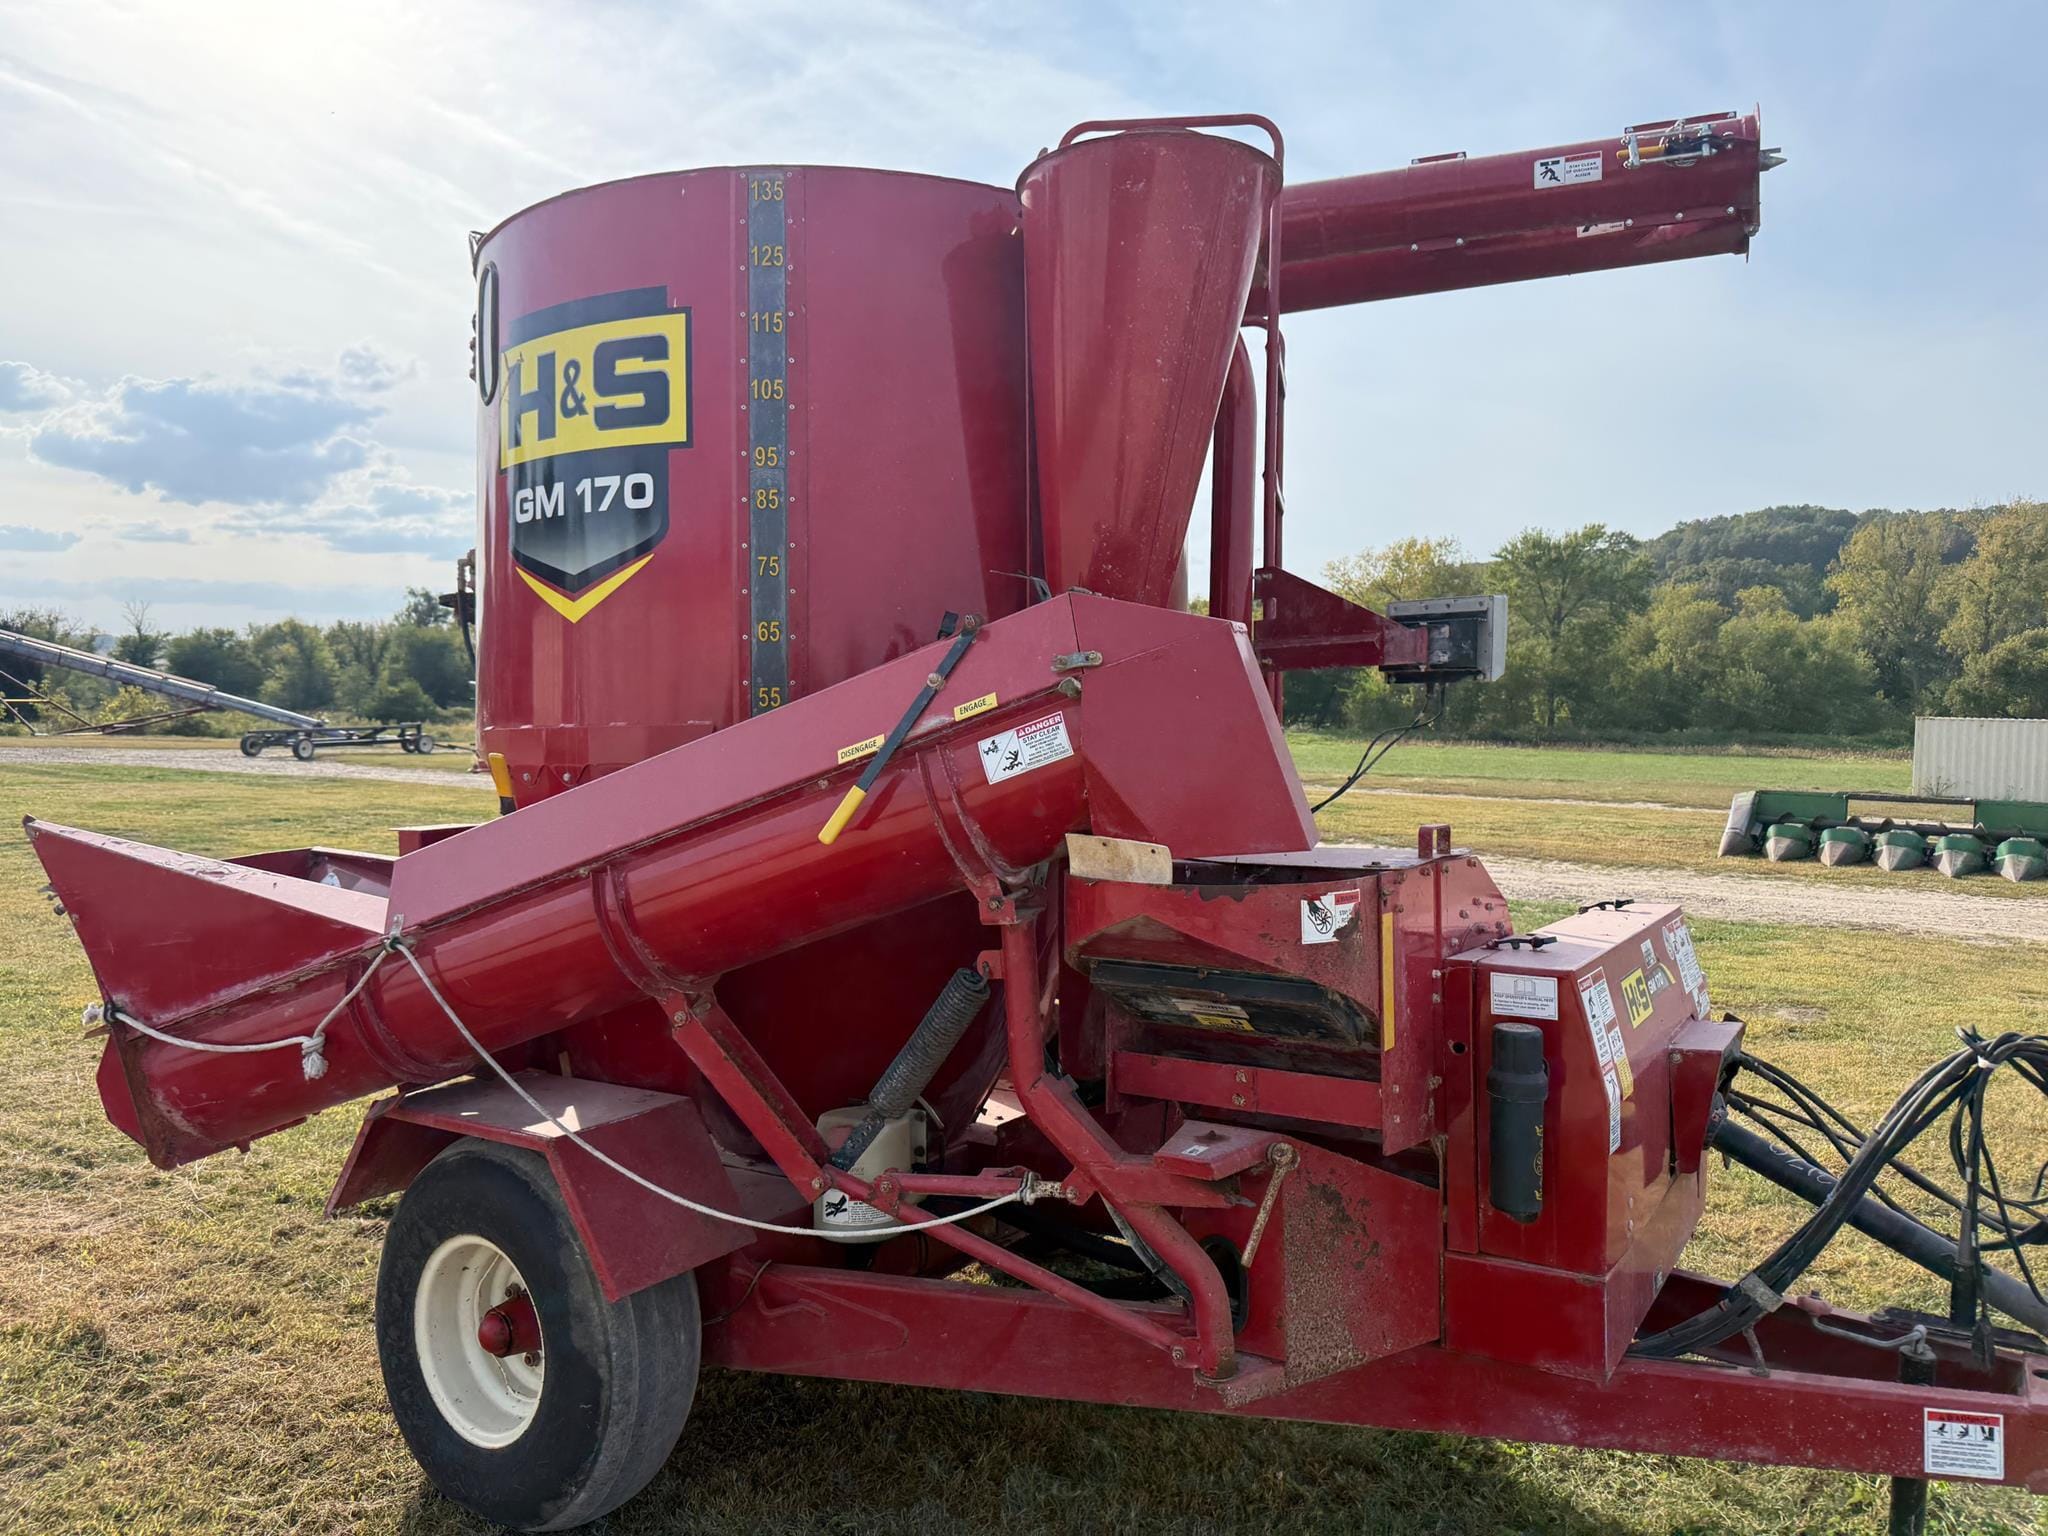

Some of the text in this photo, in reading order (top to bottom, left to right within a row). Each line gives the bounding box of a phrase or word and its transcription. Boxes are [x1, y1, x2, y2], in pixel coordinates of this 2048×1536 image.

[751, 180, 784, 201] 135
[751, 245, 784, 267] 125
[751, 312, 784, 333] 115
[507, 333, 670, 450] H&S
[751, 379, 784, 400] 105
[754, 446, 778, 467] 95
[514, 472, 655, 524] GM 170
[755, 489, 779, 510] 85
[757, 556, 780, 577] 75
[758, 621, 781, 642] 65
[759, 687, 781, 708] 55
[959, 697, 987, 715] ENGAGE
[1022, 726, 1060, 744] STAY CLEAR
[1024, 715, 1062, 735] DANGER
[840, 739, 877, 760] DISENGAGE
